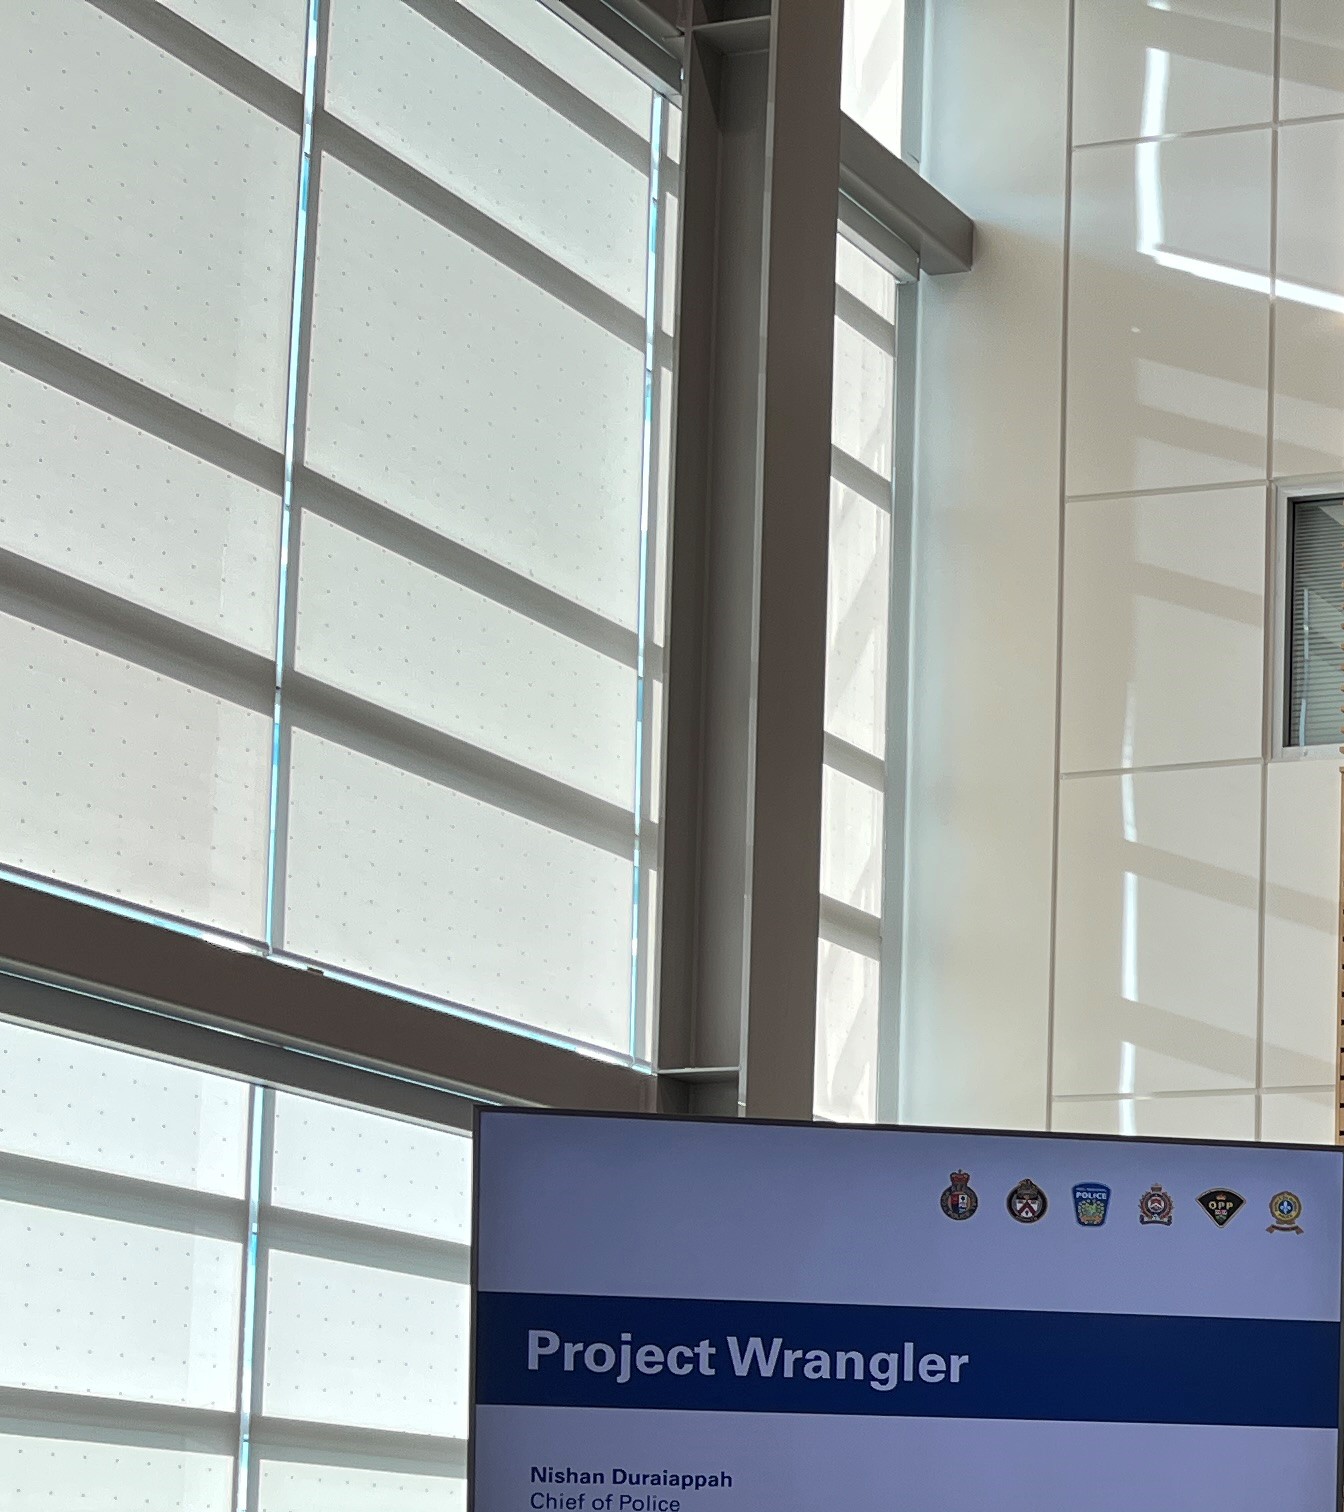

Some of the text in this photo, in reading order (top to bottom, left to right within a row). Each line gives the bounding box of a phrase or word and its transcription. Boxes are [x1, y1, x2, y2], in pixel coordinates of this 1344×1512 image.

[1075, 1191, 1107, 1200] POLICE
[1208, 1201, 1233, 1210] OPP
[528, 1330, 969, 1392] Project Wrangler
[531, 1467, 733, 1490] Nishan Duraiappah
[530, 1491, 585, 1511] Chief
[591, 1493, 613, 1511] of
